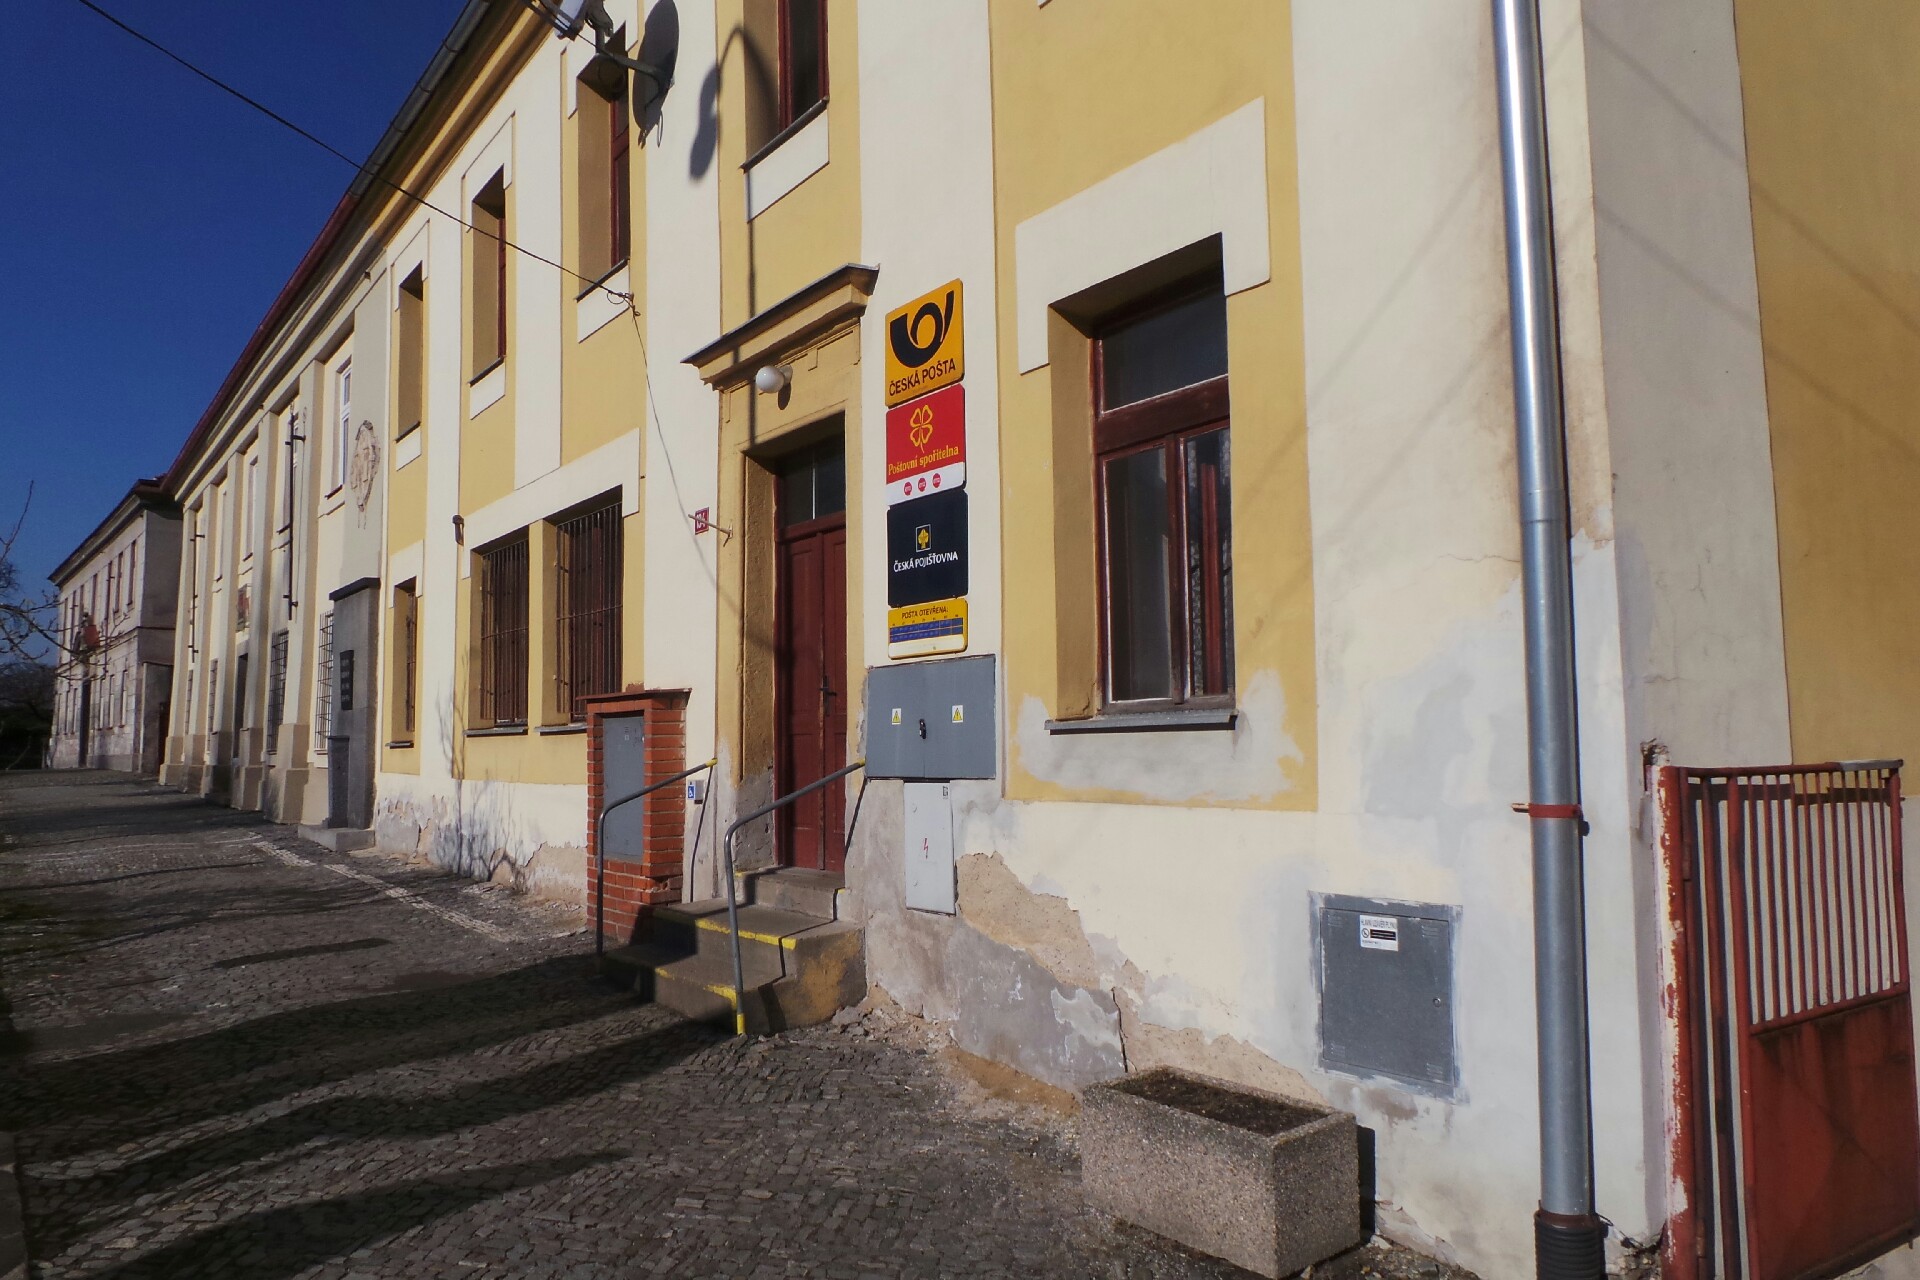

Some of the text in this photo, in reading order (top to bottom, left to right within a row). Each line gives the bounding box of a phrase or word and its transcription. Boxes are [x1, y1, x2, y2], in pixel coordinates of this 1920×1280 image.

[889, 358, 956, 396] ČESKÁ POŠTA
[888, 445, 959, 475] Poštovní spořitelna
[893, 551, 958, 573] ČESKÁ POJIŠŤOVNA
[902, 609, 918, 619] POŠTA
